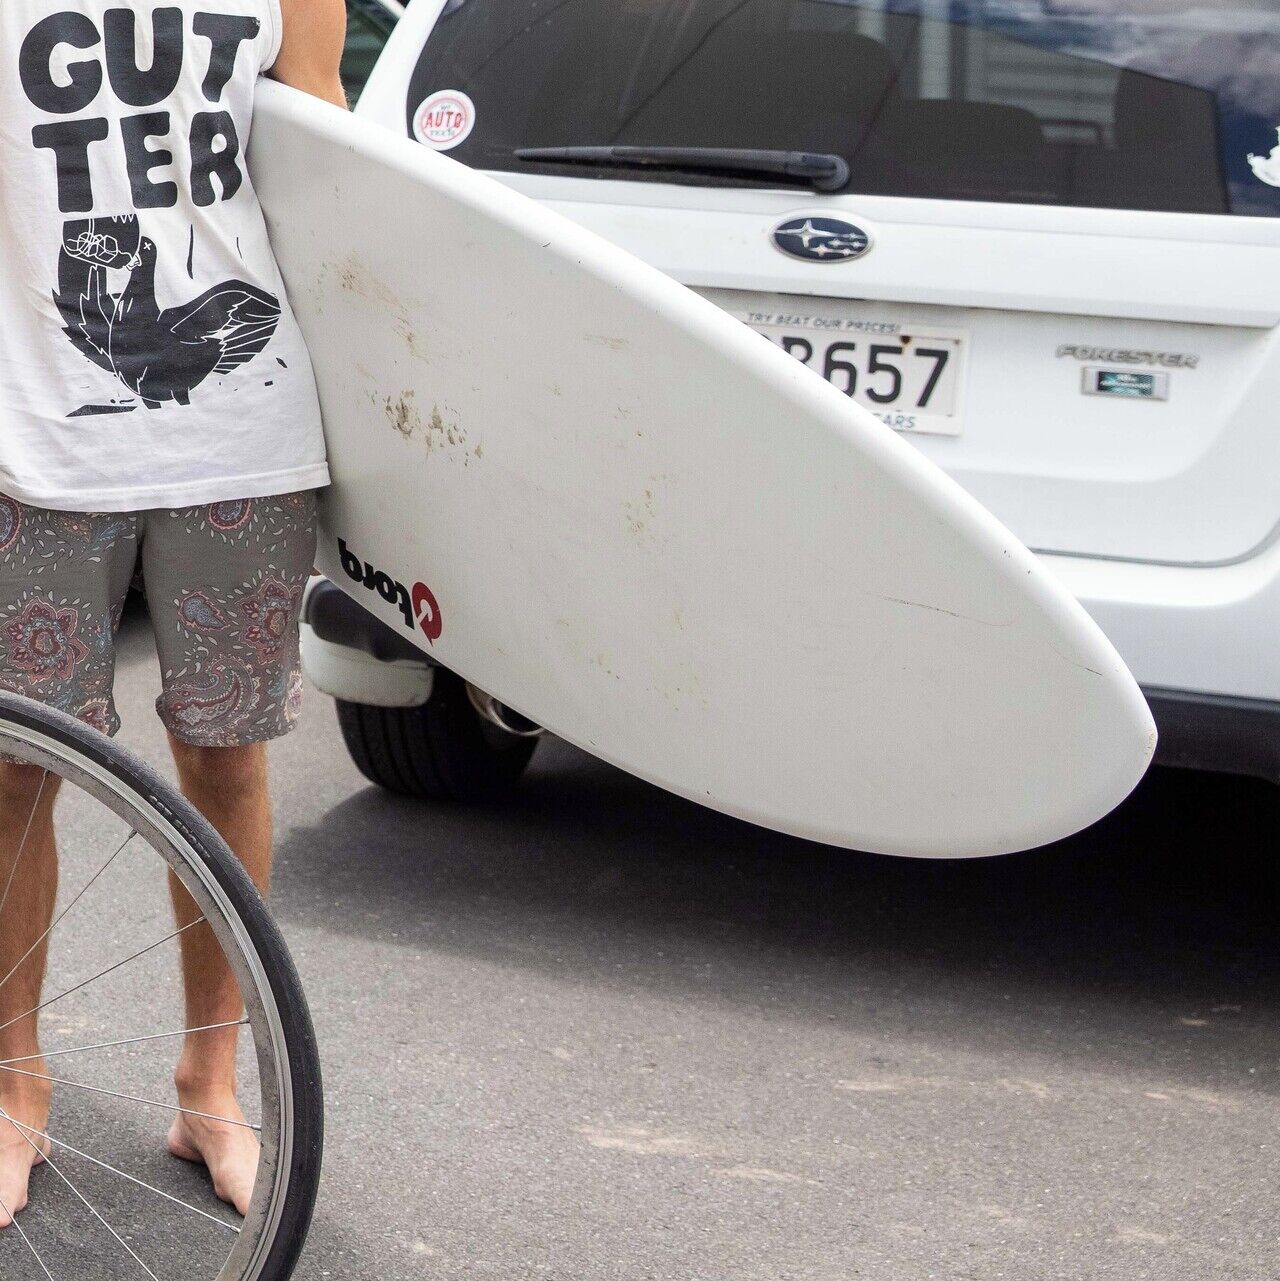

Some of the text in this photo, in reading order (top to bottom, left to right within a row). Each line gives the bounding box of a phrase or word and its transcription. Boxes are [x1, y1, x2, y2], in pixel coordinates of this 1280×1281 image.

[19, 7, 260, 114] GUT
[424, 111, 463, 129] AUTO
[32, 111, 243, 213] TER
[815, 318, 842, 329] OUR
